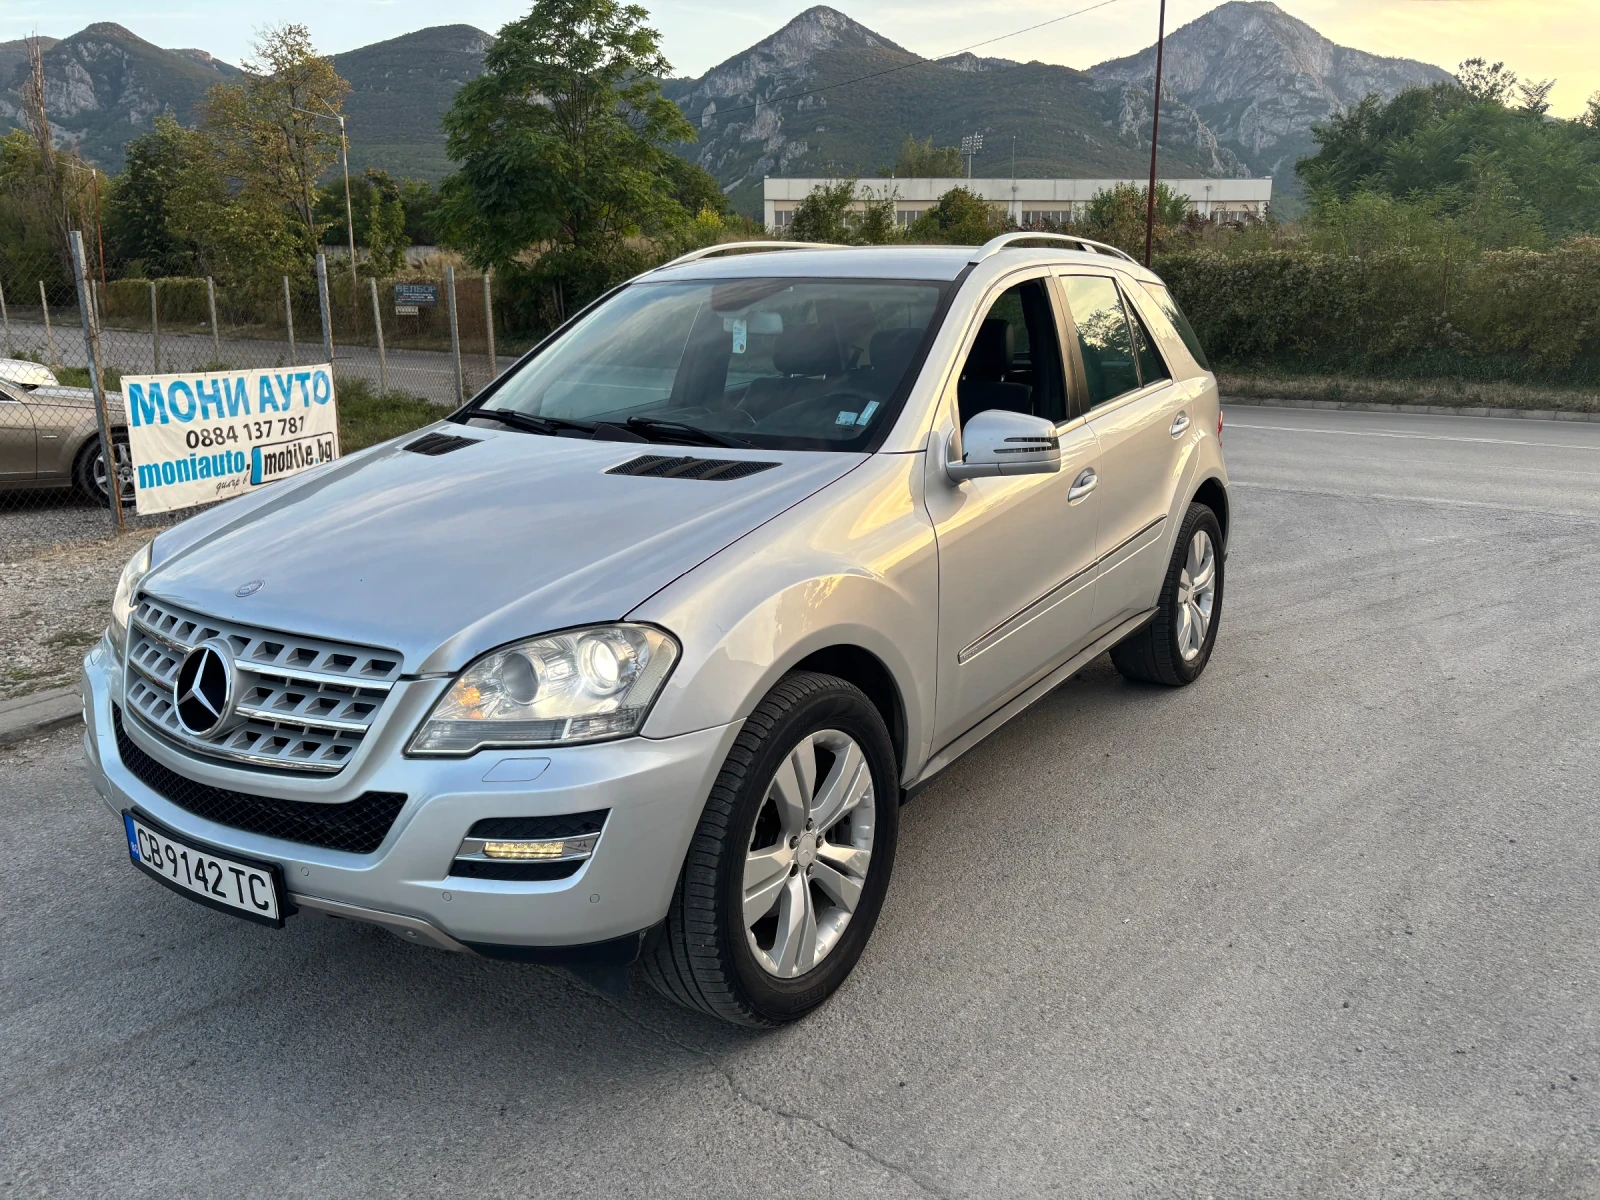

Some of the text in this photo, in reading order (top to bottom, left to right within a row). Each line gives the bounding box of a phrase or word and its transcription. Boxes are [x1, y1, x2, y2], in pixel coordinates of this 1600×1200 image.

[128, 370, 331, 427] МОНИ АУТО
[186, 415, 305, 449] 0884 137 781
[130, 841, 139, 855] BG
